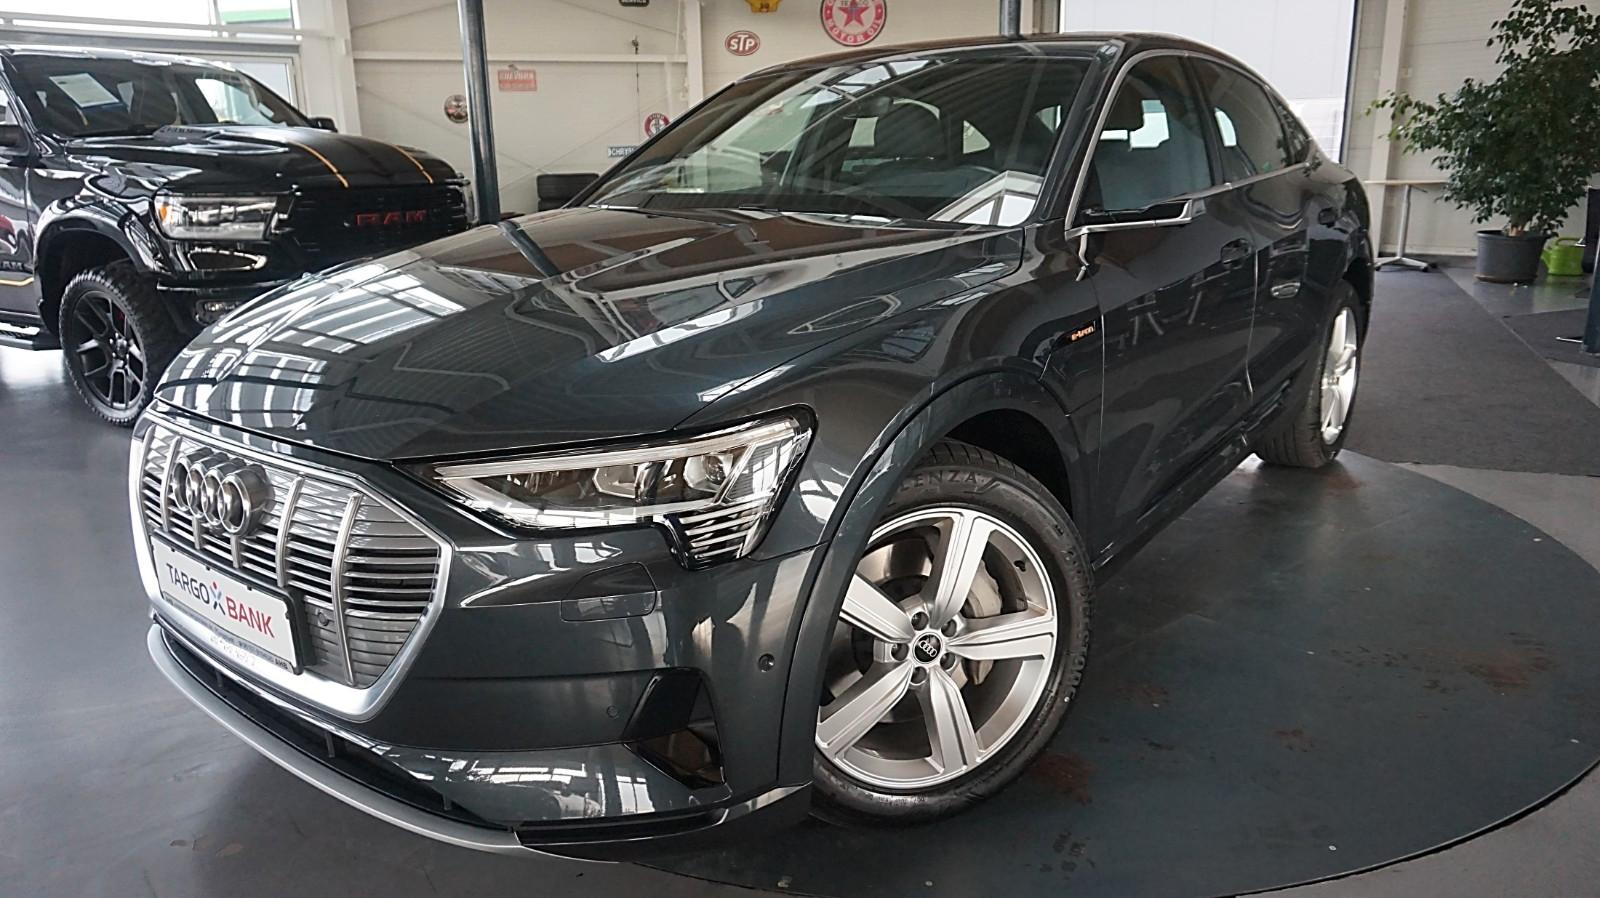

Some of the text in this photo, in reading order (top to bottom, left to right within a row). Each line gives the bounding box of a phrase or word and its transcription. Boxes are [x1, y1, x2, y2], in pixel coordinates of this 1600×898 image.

[826, 18, 882, 43] MOTOR OIL
[730, 34, 755, 51] STP
[356, 209, 428, 226] RAM
[0, 260, 23, 270] AM
[900, 469, 978, 492] LENZA
[166, 562, 210, 605] TARGO
[225, 595, 275, 639] BANK
